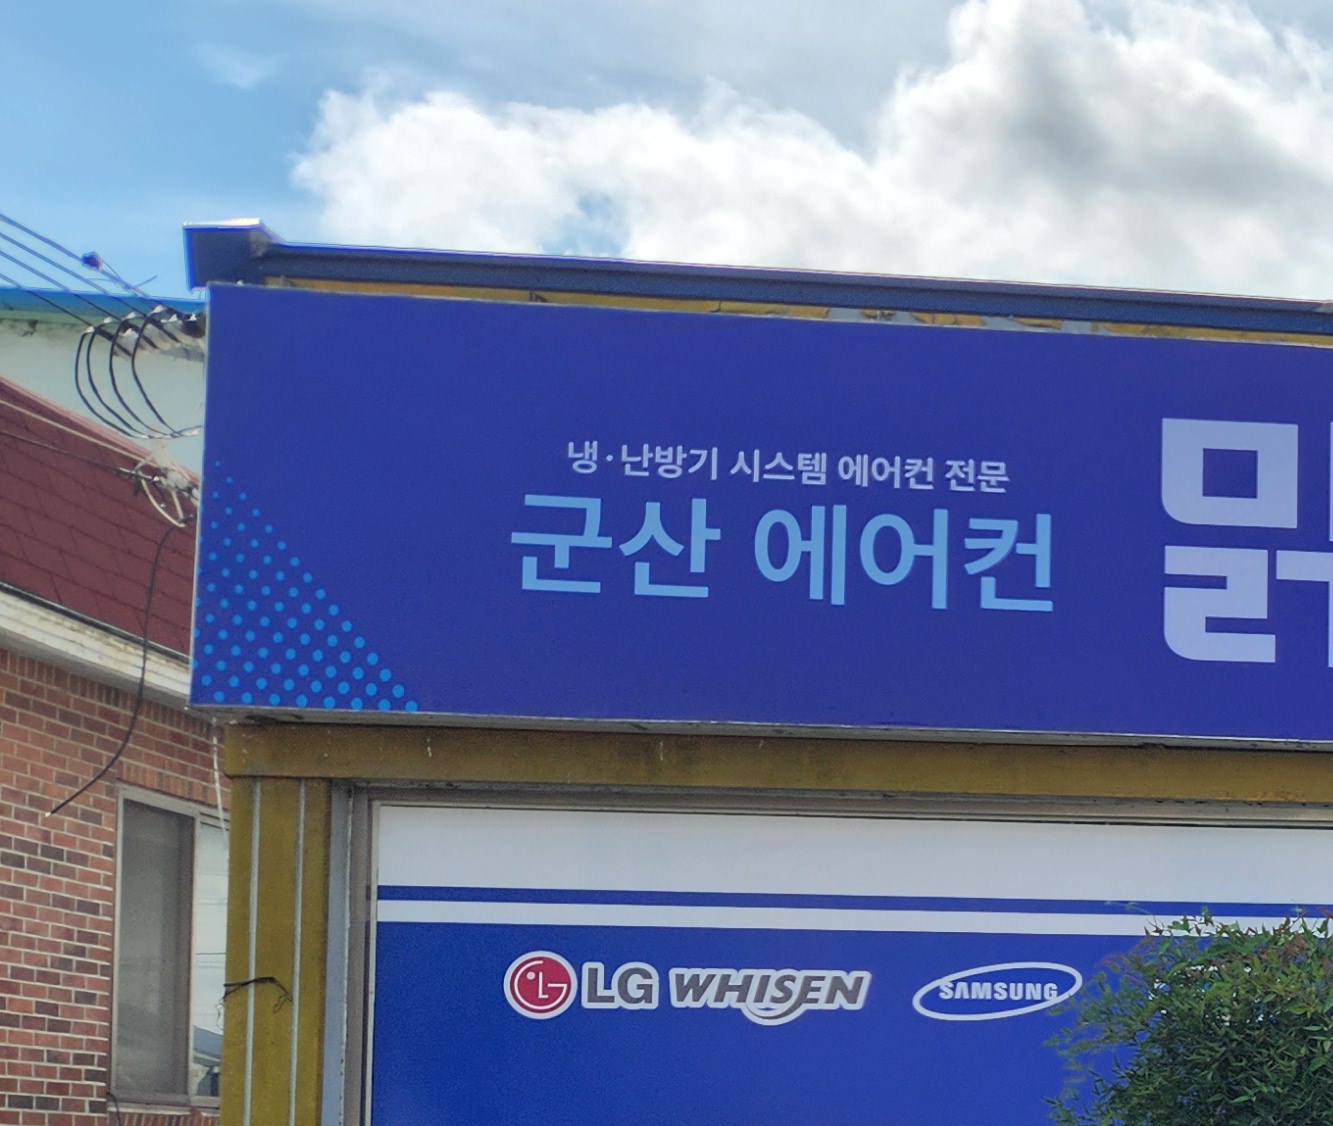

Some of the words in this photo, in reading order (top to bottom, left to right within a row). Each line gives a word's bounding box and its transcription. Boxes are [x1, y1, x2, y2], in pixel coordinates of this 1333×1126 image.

[567, 440, 718, 480] 냉·난방기
[730, 449, 828, 485] 시스템
[838, 453, 935, 490] 에어컨
[944, 458, 1009, 493] 전문
[511, 494, 721, 598] 군산
[754, 504, 1053, 611] 에어컨
[588, 967, 653, 1004] LG
[675, 972, 864, 1019] WHISEN
[939, 981, 1058, 1000] SAMSUNG
